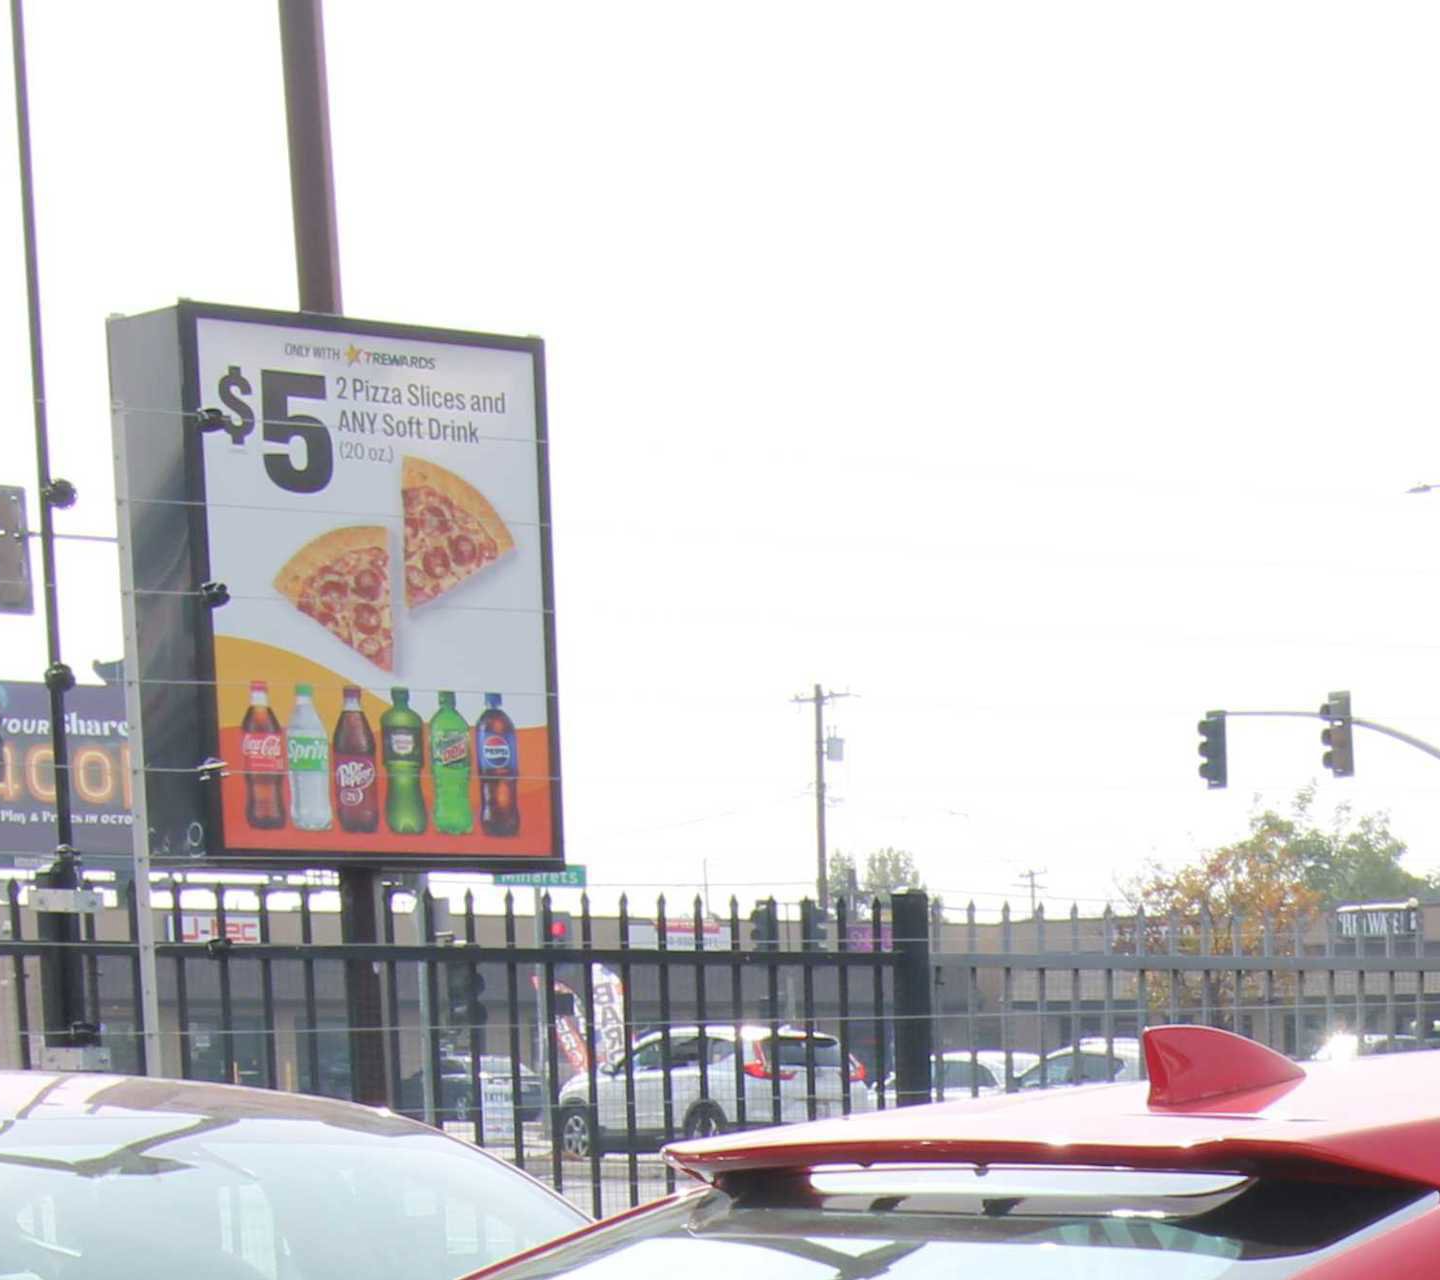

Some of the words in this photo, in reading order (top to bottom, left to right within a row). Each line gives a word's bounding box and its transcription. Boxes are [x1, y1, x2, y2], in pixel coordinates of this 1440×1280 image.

[284, 343, 310, 357] ONLY
[313, 346, 340, 360] WITH
[336, 376, 347, 400] 2
[352, 380, 402, 405] Pizza
[407, 383, 466, 411] Slices
[470, 392, 506, 414] and
[217, 365, 334, 495] $5
[338, 410, 377, 434] ANY
[383, 414, 423, 439] Soft
[429, 420, 480, 443] Drink
[339, 442, 364, 461] (20
[369, 446, 394, 463] oz.)
